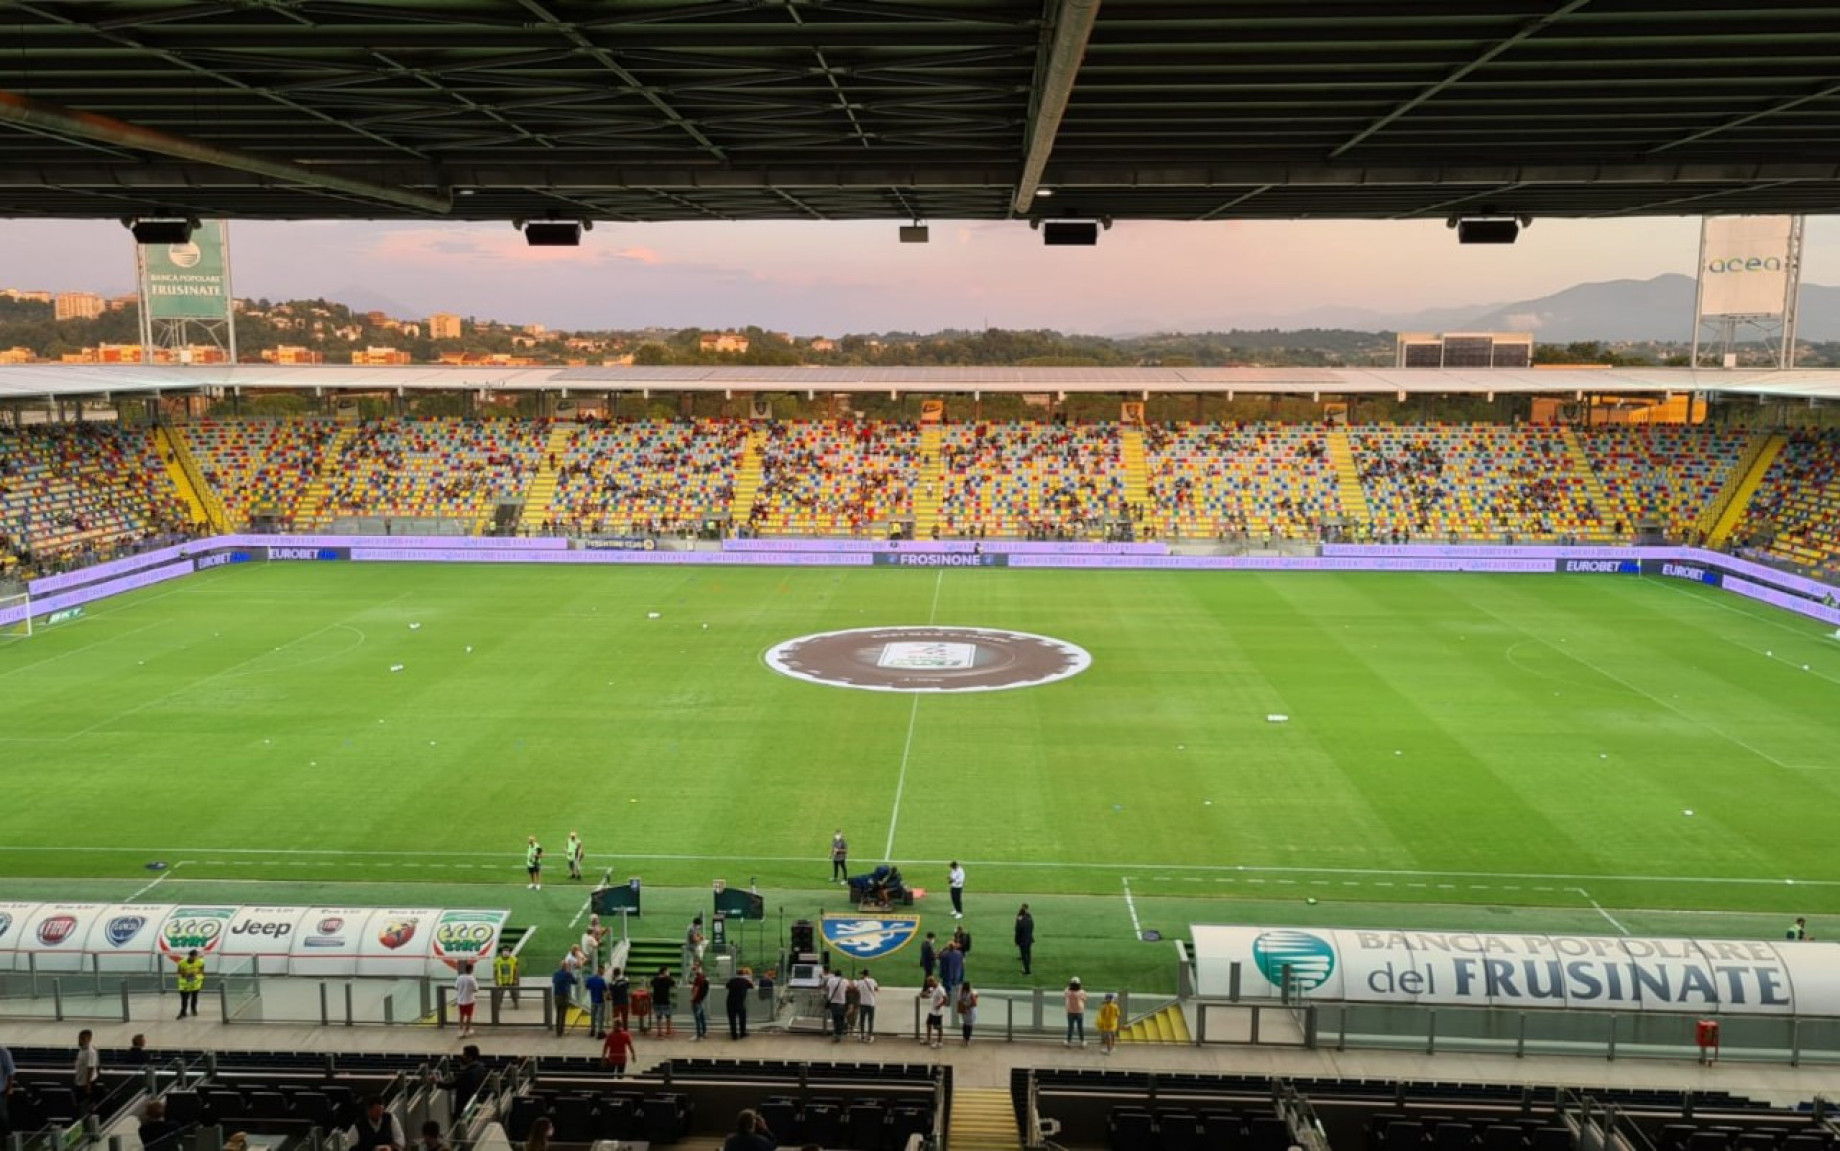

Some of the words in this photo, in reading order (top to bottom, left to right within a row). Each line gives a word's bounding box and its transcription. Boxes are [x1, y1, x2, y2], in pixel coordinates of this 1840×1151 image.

[1709, 257, 1780, 273] acea
[150, 274, 179, 282] BANCA
[151, 285, 221, 296] FRUSINATE
[269, 549, 320, 560] EUROBET
[901, 554, 981, 566] FROSINONE
[1566, 560, 1621, 572] EUROBET
[231, 918, 292, 938] Jeep
[1356, 932, 1516, 953] BANCA
[1520, 937, 1776, 961] POPOLARE
[1367, 961, 1436, 994] del
[1453, 957, 1791, 1006] FRUSINATE
